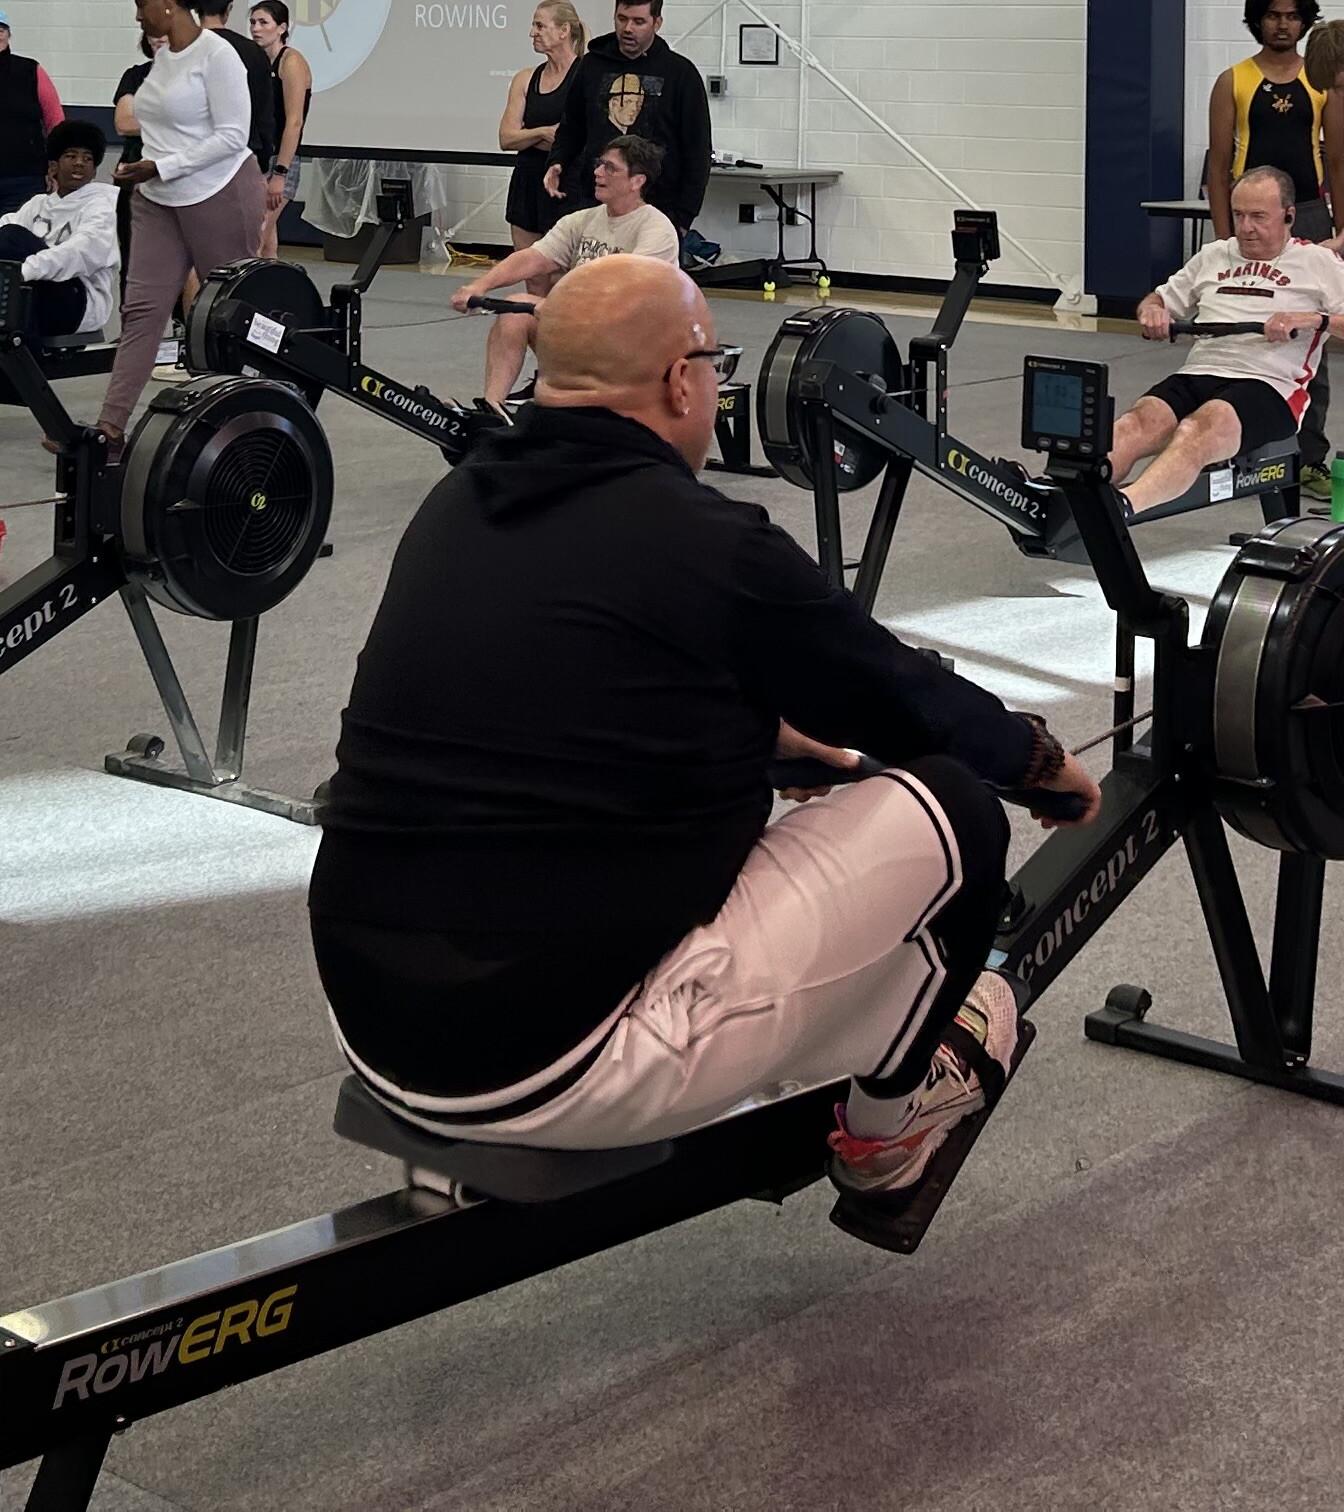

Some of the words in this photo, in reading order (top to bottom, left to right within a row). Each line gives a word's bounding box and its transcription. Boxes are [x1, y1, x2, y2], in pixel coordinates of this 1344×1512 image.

[415, 3, 508, 30] ROWING
[1217, 261, 1291, 287] MARINES
[383, 388, 449, 430] concept
[448, 420, 461, 436] 2
[968, 464, 1029, 512] concept
[1029, 501, 1040, 519] 2
[59, 583, 79, 610] 2
[1017, 833, 1139, 984] concept
[1141, 809, 1160, 845] 2
[120, 1319, 174, 1347] concept
